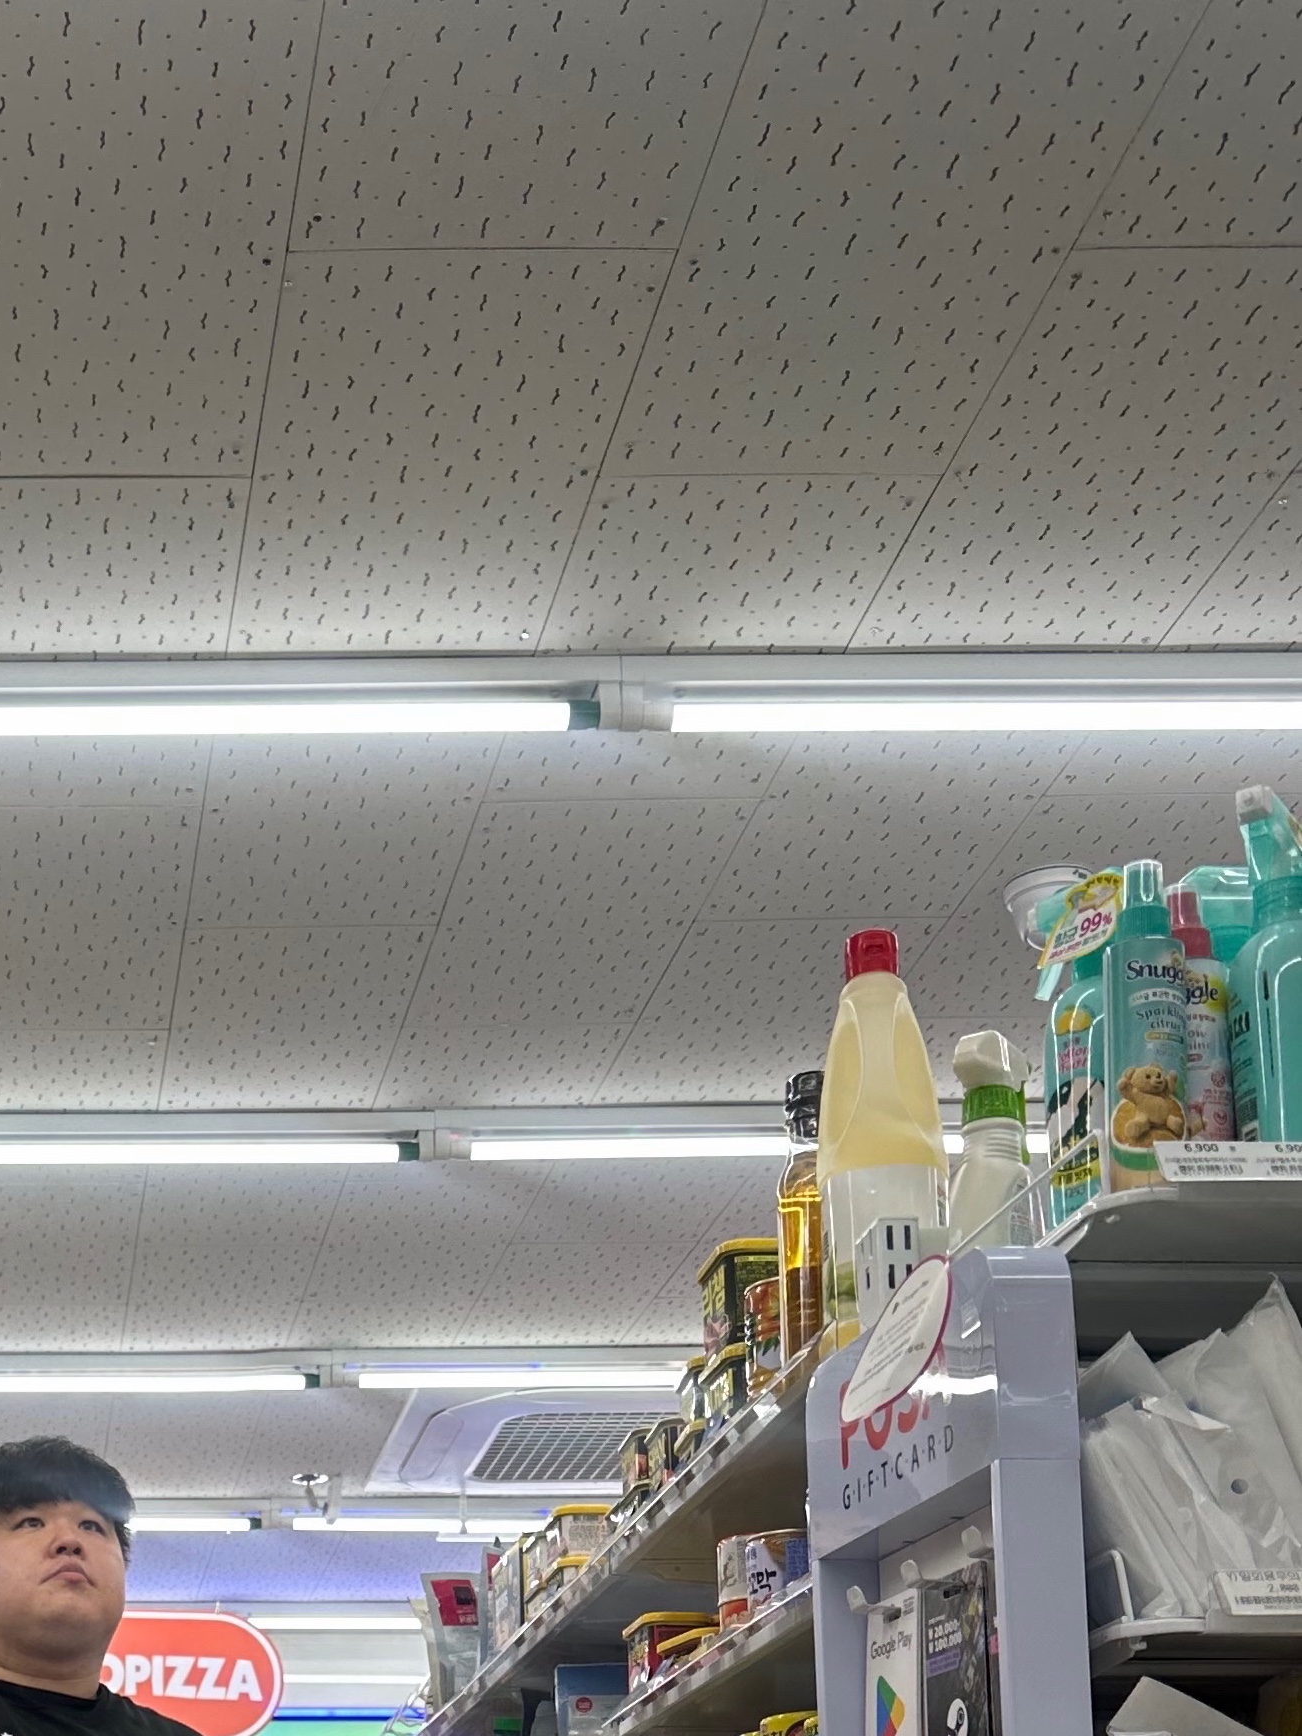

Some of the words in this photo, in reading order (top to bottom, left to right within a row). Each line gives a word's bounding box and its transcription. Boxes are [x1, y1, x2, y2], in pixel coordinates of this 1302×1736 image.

[1079, 911, 1113, 936] 99%
[870, 1635, 897, 1660] Google
[898, 1631, 913, 1651] Play
